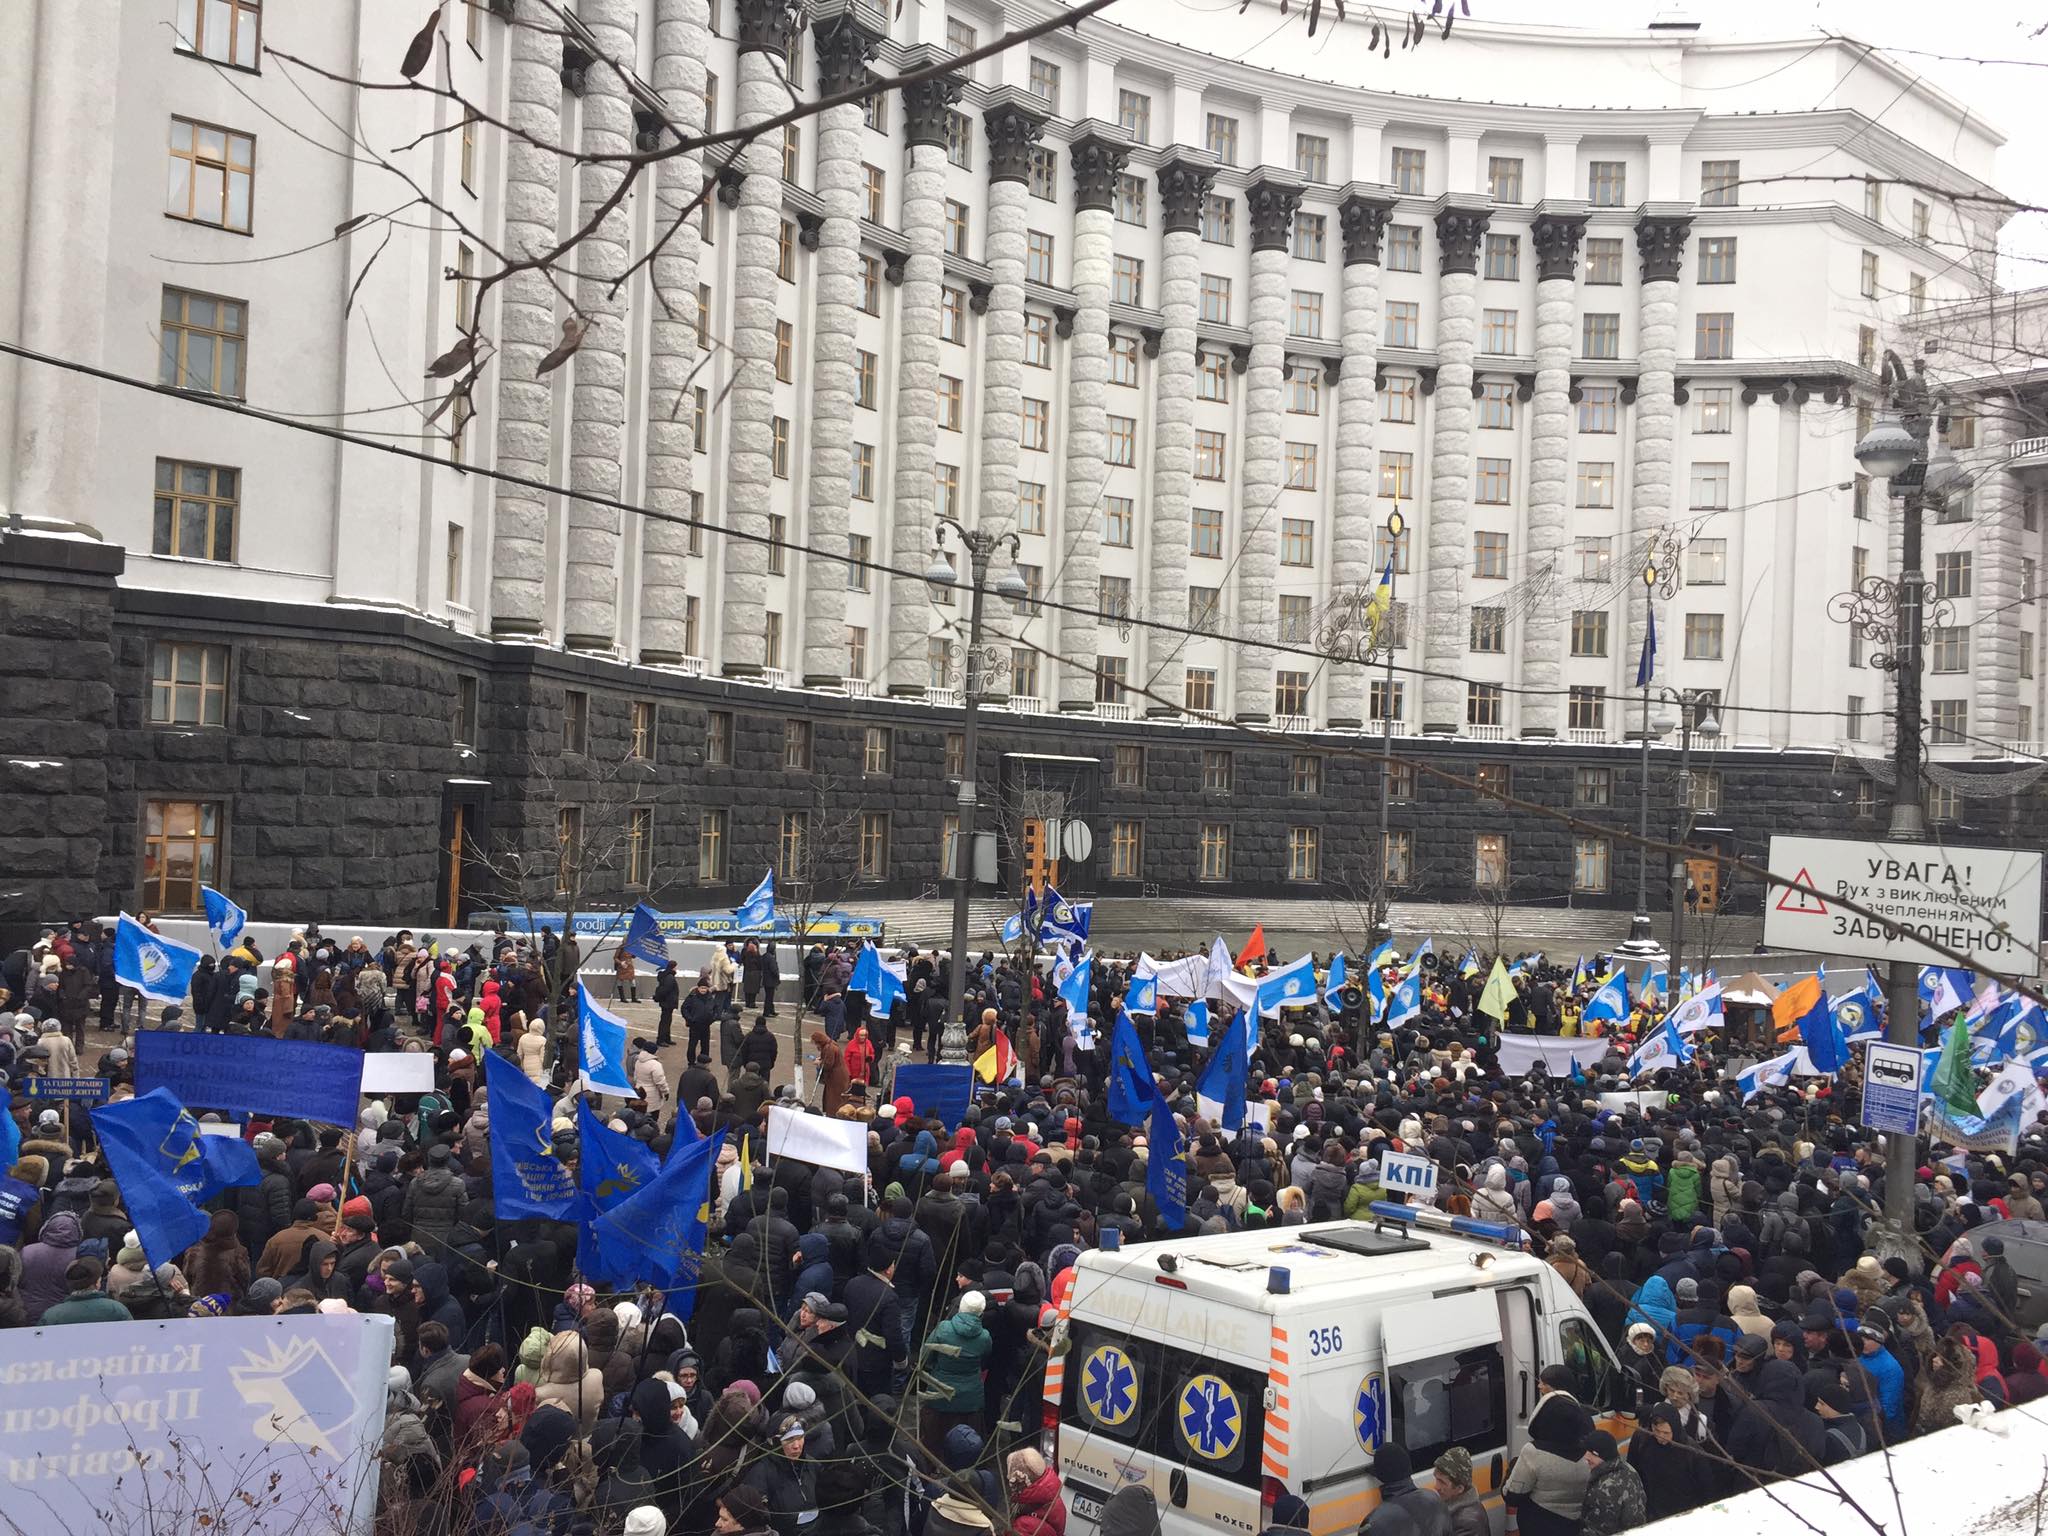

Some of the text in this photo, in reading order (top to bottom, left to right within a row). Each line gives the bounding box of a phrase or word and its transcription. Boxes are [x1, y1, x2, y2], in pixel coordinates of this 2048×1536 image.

[1867, 859, 1972, 886] УВАГА!
[1836, 880, 1869, 900] Рух
[1890, 889, 2007, 909] виключеним
[1866, 903, 1973, 922] зчепленням
[576, 918, 606, 933] oodji
[695, 920, 730, 930] ТВОГО
[1089, 1289, 1249, 1346] AMBULANCE
[1309, 1325, 1342, 1356] 356
[1064, 1457, 1108, 1478] PEUGEOT
[1214, 1511, 1253, 1531] BOXER
